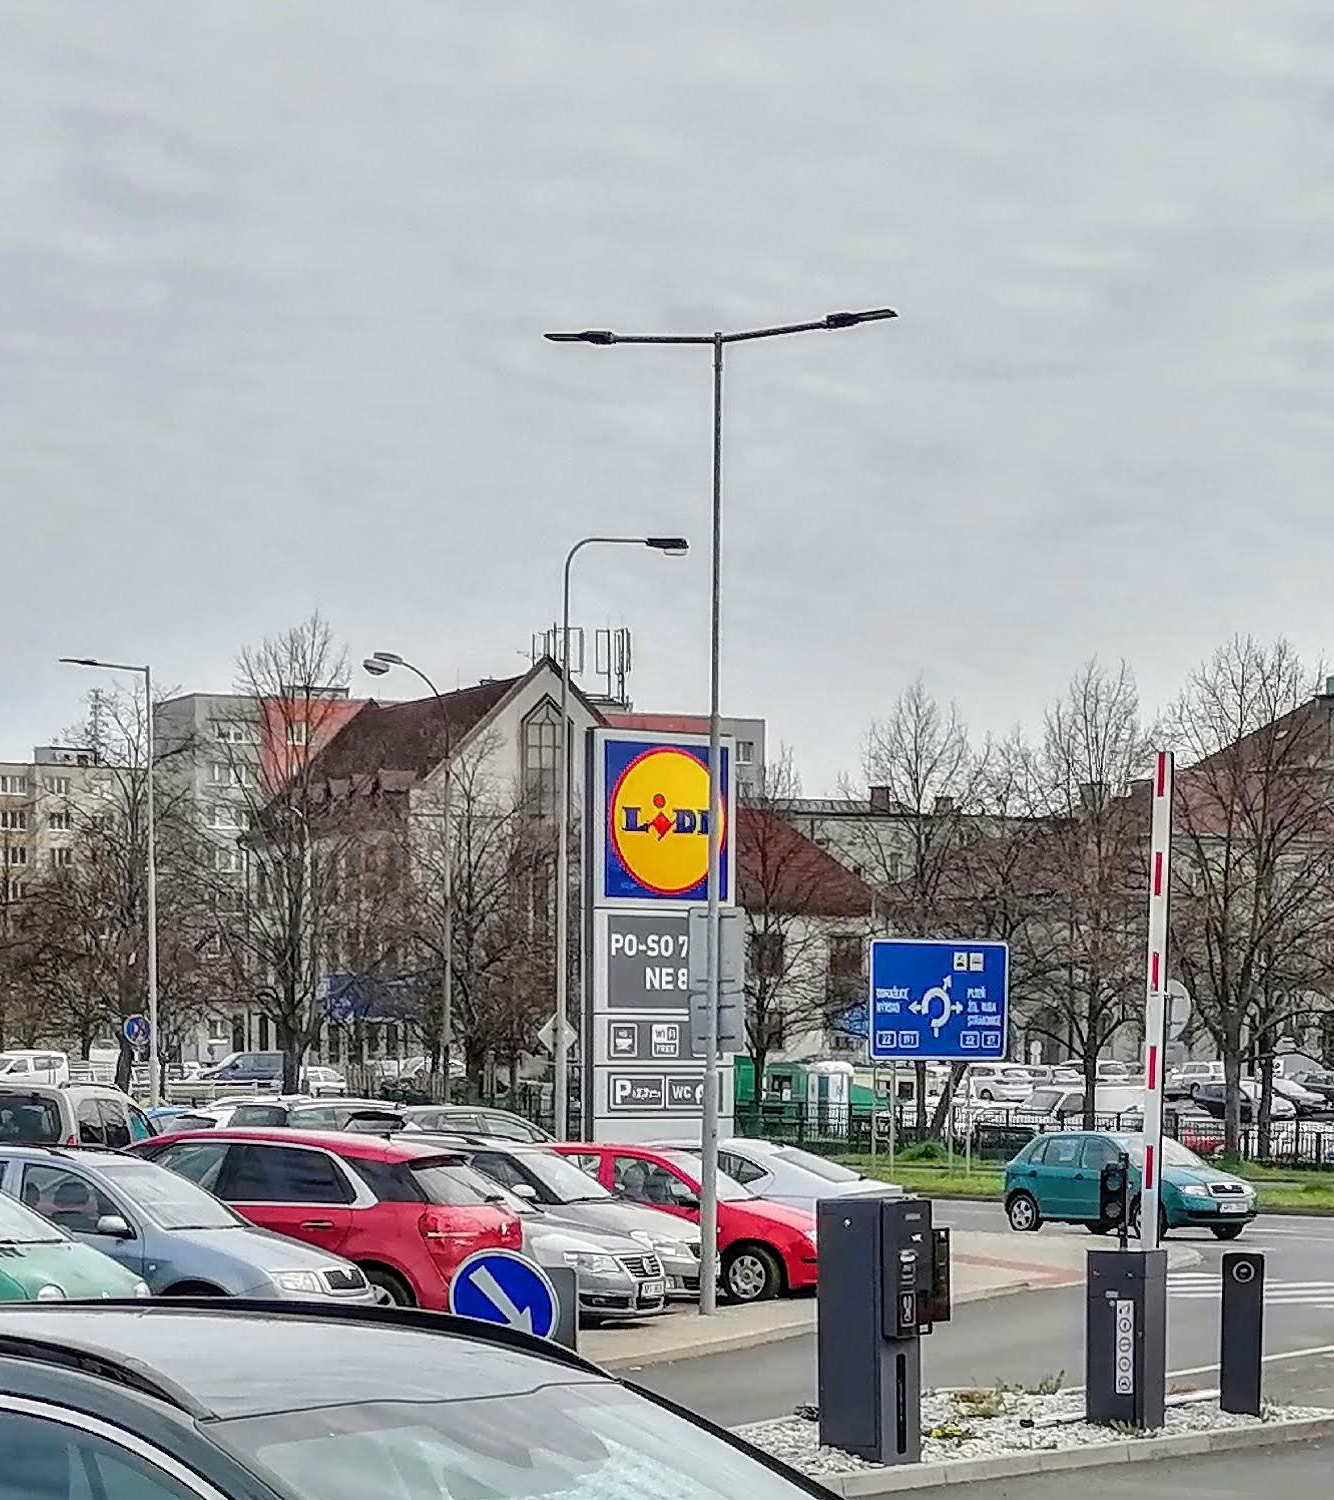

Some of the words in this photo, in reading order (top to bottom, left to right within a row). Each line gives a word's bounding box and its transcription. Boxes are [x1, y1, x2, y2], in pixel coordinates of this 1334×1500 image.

[611, 933, 674, 957] PO-SO
[645, 967, 674, 990] NE
[615, 1080, 632, 1104] P
[672, 1086, 692, 1099] WC
